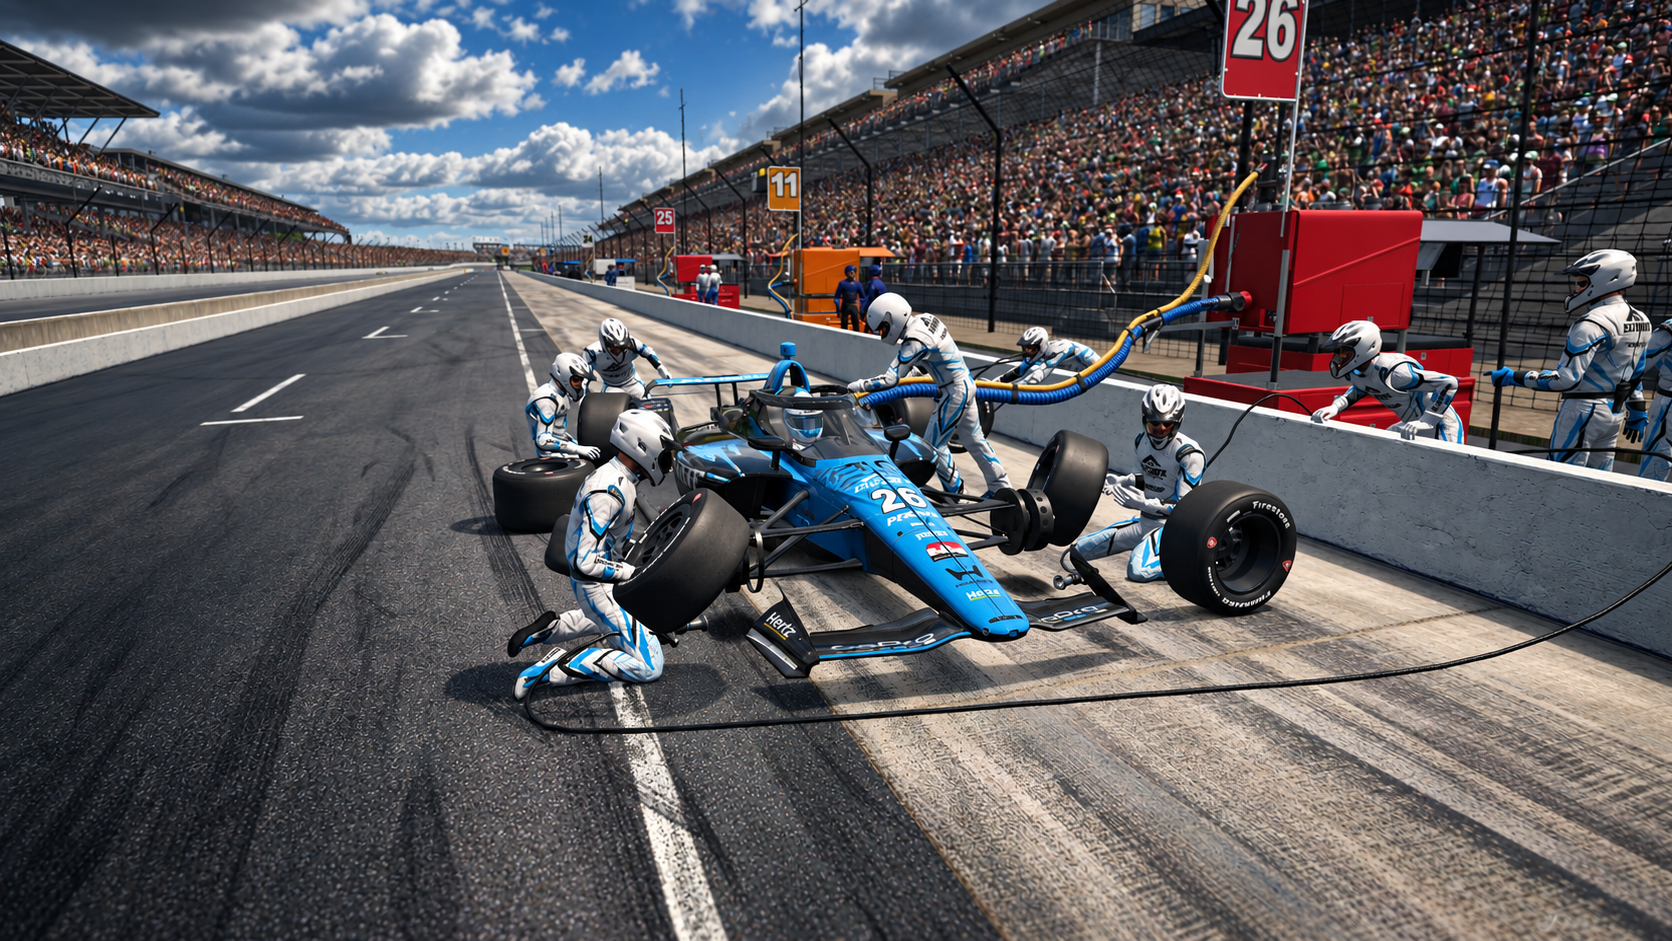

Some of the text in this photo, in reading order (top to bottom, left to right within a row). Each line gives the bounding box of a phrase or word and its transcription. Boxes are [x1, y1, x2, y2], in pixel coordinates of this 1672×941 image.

[1230, 0, 1300, 62] 26
[771, 171, 798, 198] 11
[656, 210, 673, 225] 25
[871, 486, 928, 514] 26
[765, 611, 797, 639] Hertz
